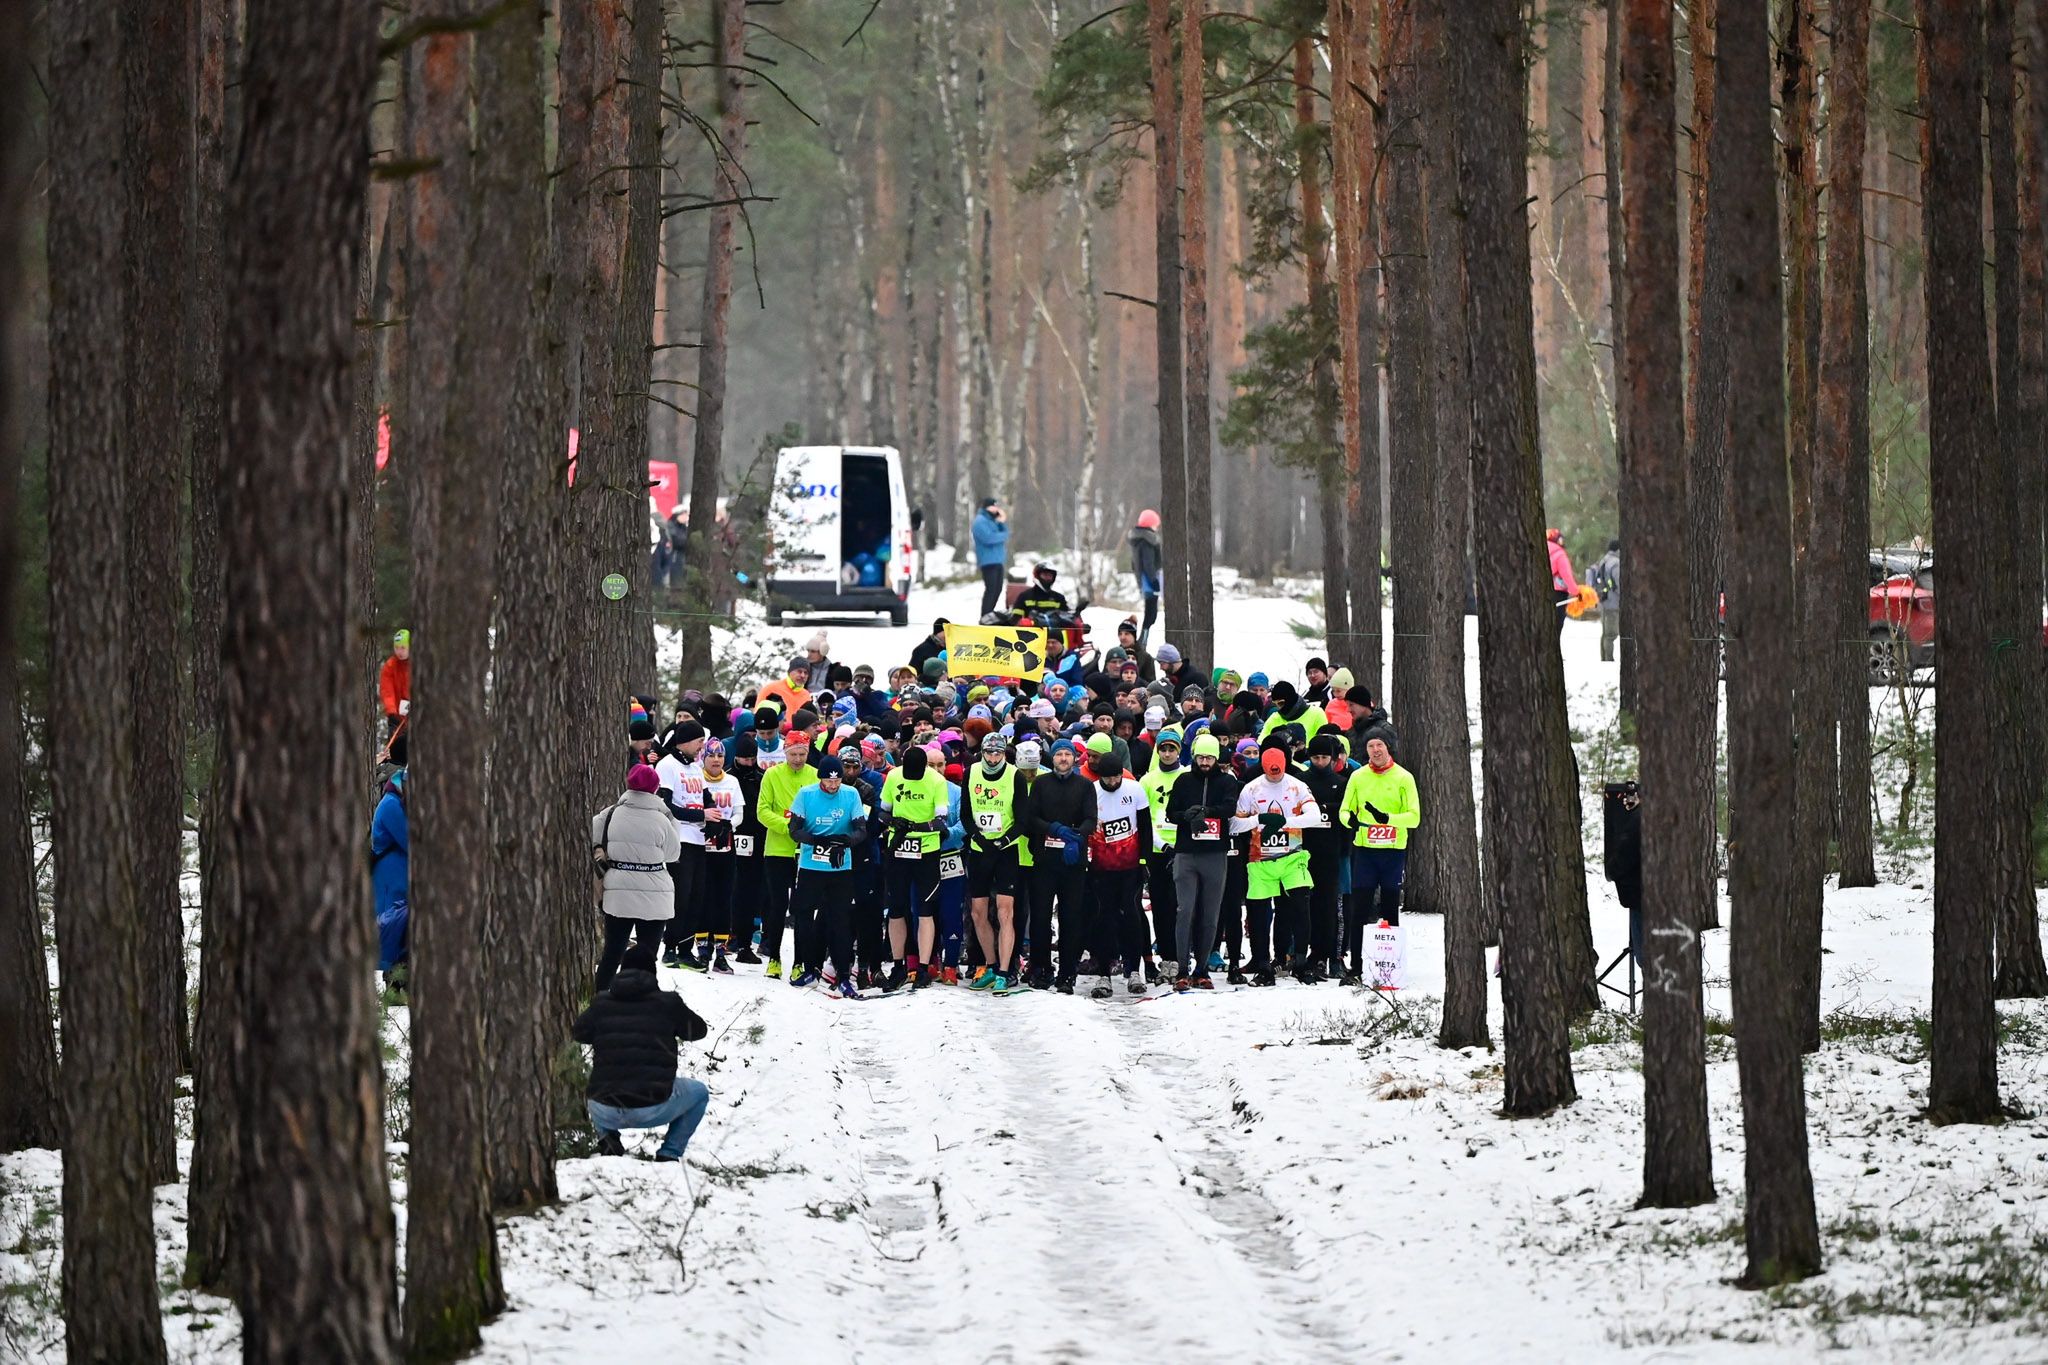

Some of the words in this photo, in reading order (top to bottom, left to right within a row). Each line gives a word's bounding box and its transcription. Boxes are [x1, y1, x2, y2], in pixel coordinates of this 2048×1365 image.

[980, 814, 994, 826] 67
[1105, 819, 1130, 837] 529
[1369, 826, 1394, 839] 227
[617, 862, 635, 870] Calvin
[940, 859, 957, 873] 26
[1374, 934, 1397, 942] META
[1374, 960, 1397, 970] META
